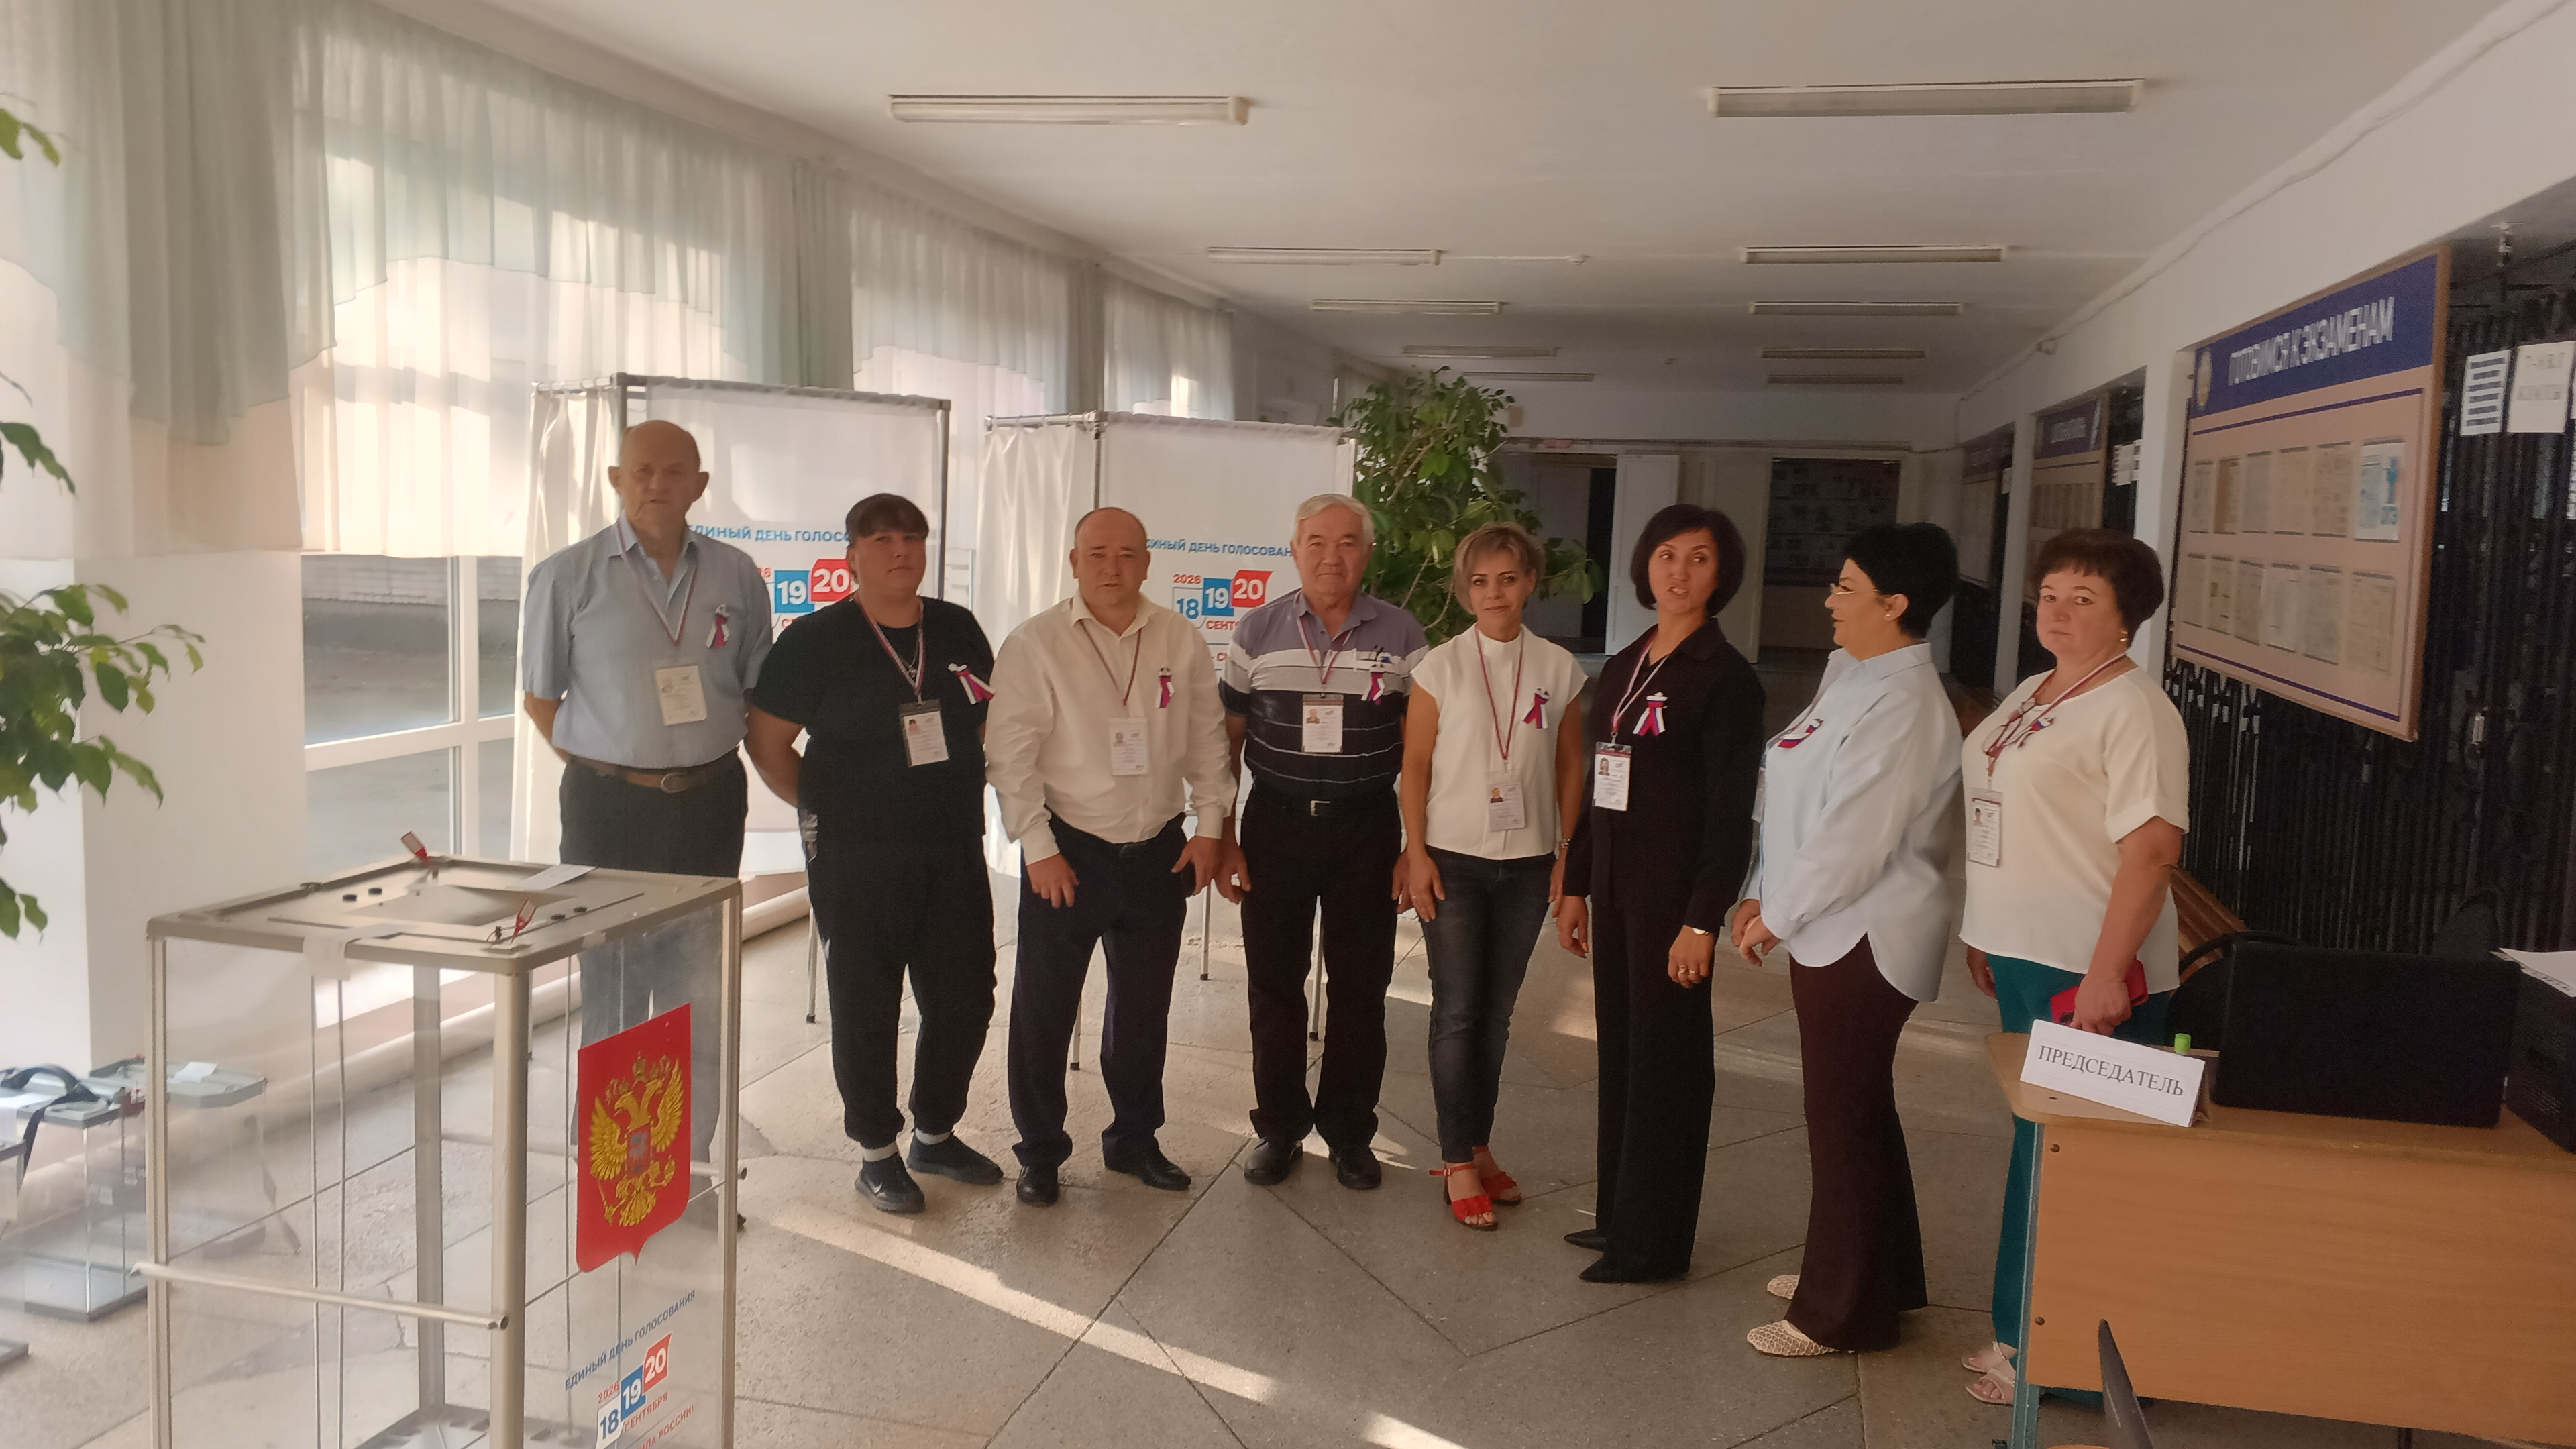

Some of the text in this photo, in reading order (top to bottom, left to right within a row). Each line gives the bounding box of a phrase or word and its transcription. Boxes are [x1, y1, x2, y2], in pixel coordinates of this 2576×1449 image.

[689, 525, 751, 539] ДИНЫЙ
[755, 529, 791, 541] ДЕНЬ
[1188, 542, 1220, 553] ДЕНЬ
[1222, 544, 1293, 557] ГОЛОСОВАН
[777, 568, 850, 605] 19 20
[1177, 578, 1264, 619] 18 19 20
[2038, 1044, 2184, 1097] ПРЕДСЕДАТЕЛЬ
[565, 1289, 695, 1391] ЕДИНЫЙ ДЕНЬ ГОЛОСОВАНИЯ
[600, 1347, 666, 1440] 18 19 20
[624, 1391, 668, 1433] СЕНТЯБРЯ
